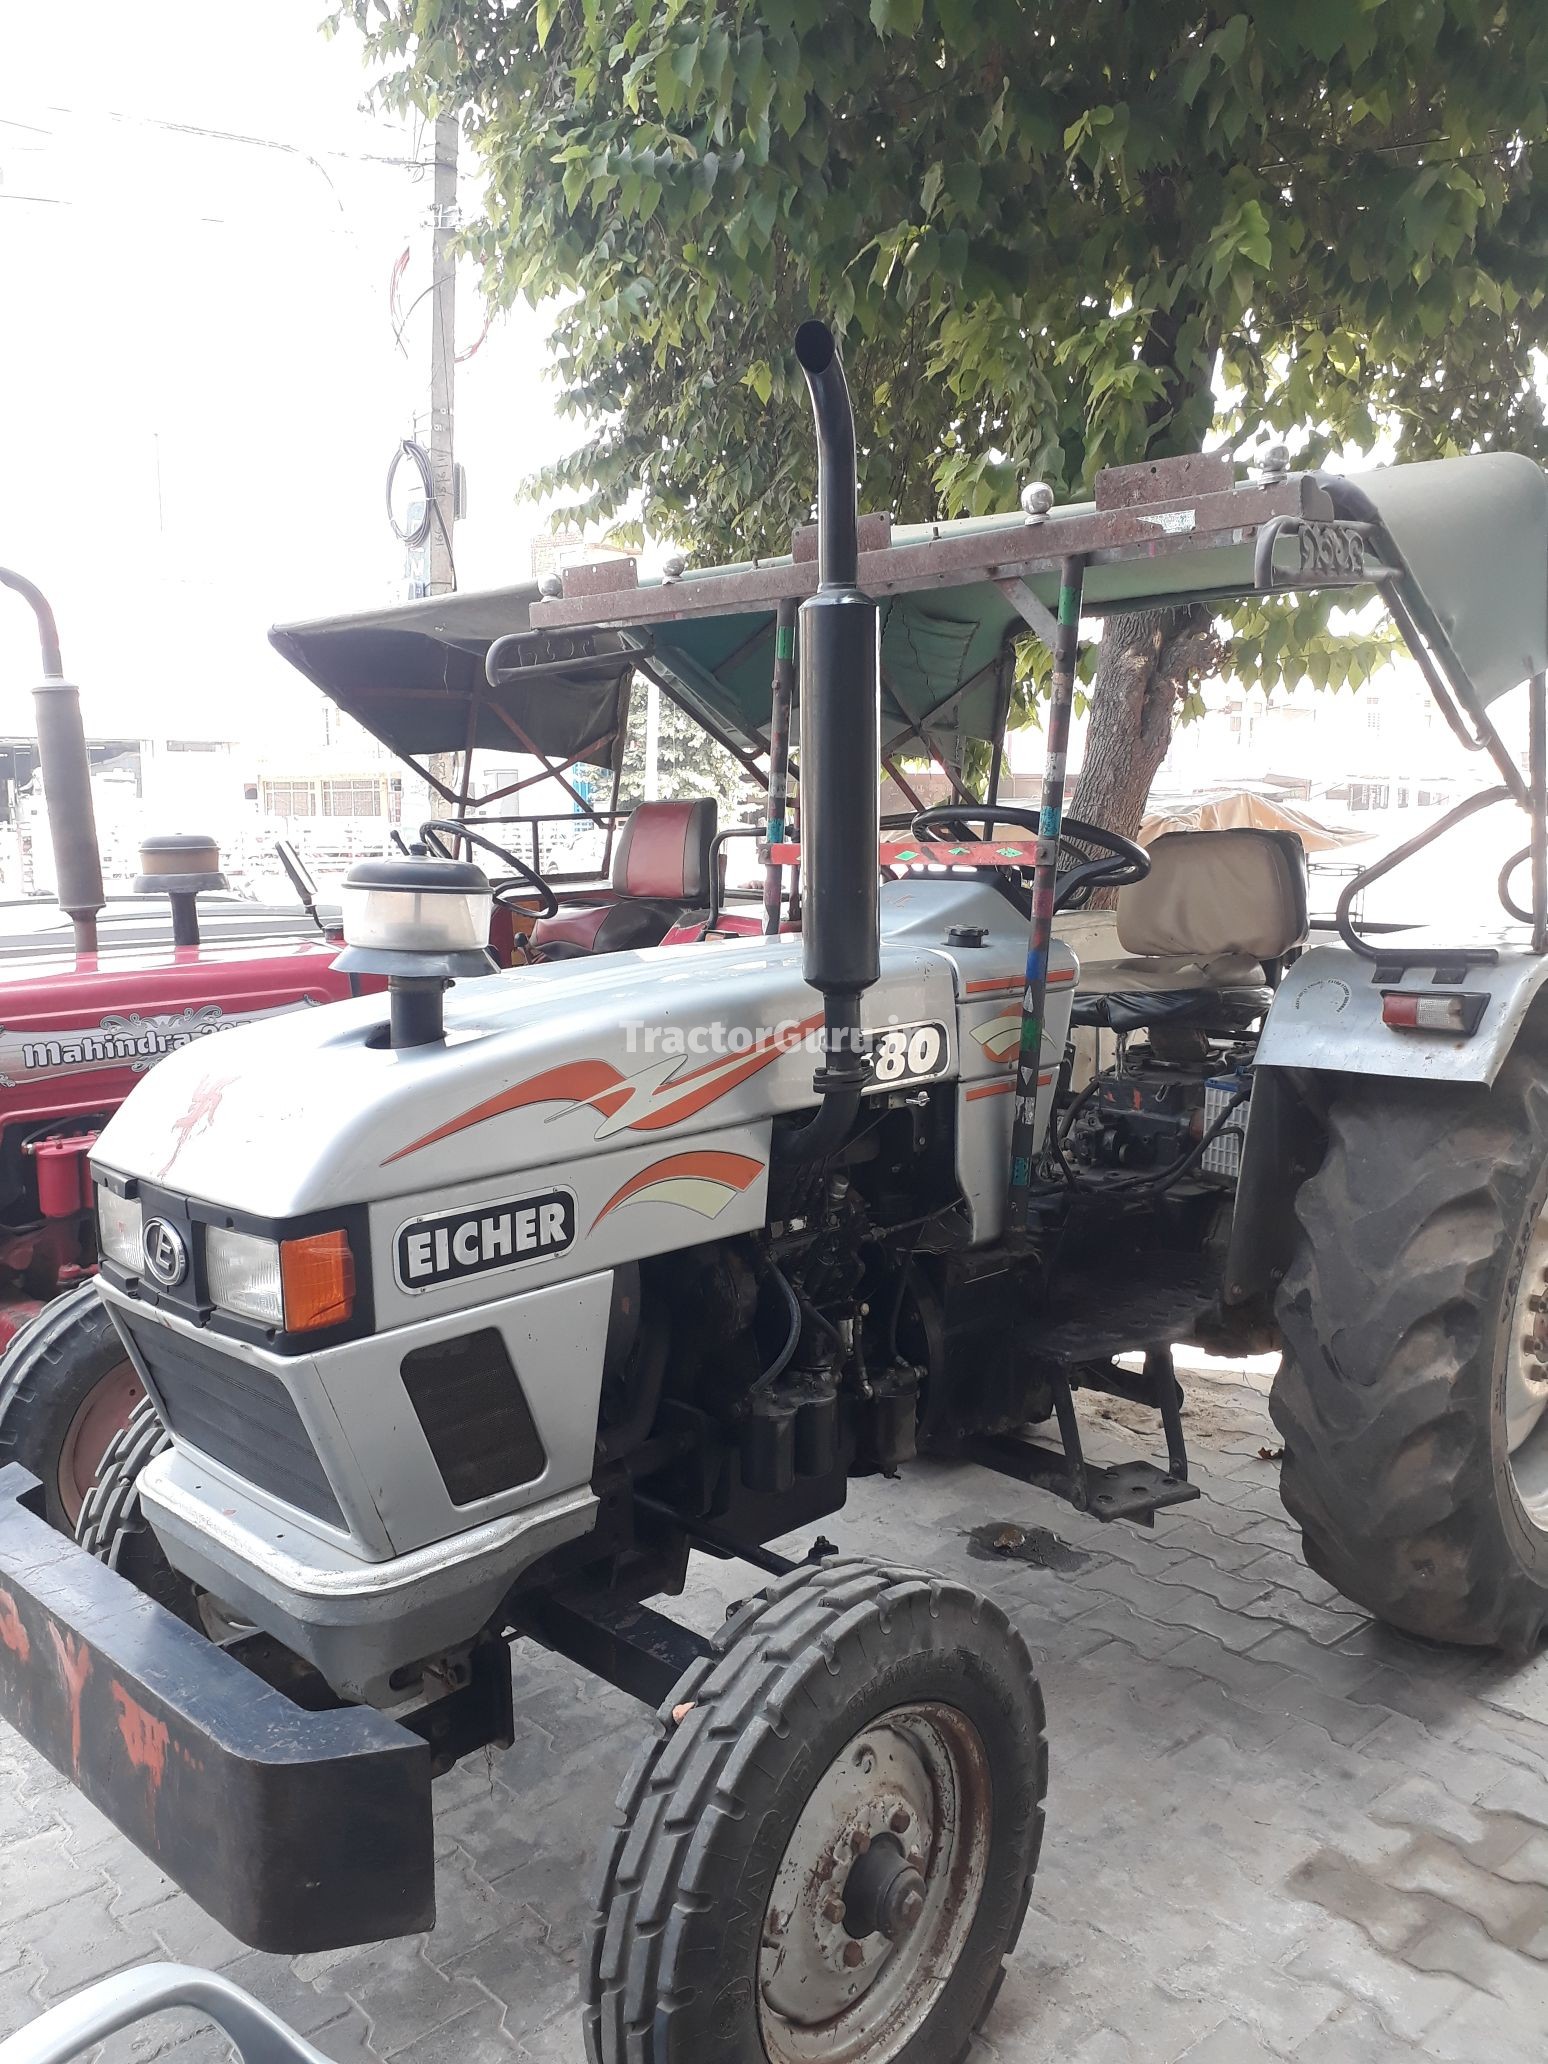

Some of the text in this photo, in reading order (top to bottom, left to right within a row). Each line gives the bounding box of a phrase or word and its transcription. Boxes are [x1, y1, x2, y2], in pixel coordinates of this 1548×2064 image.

[22, 1031, 192, 1068] Mahindra
[860, 1026, 940, 1081] 80
[407, 1202, 567, 1278] EICHER
